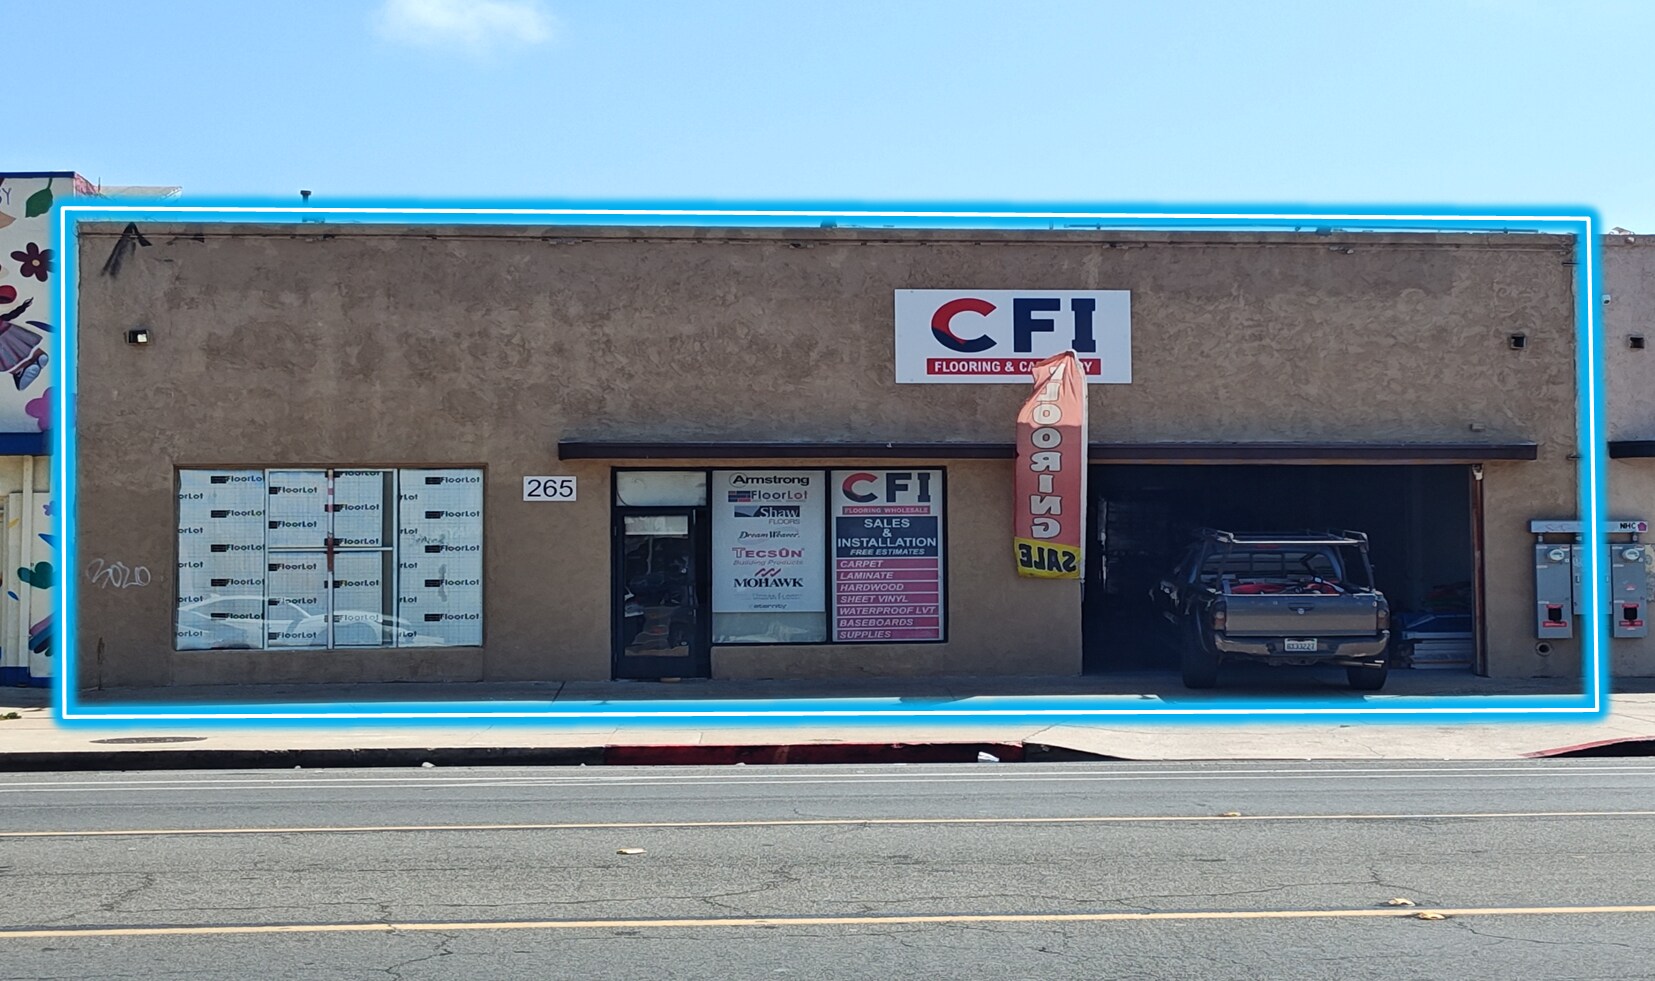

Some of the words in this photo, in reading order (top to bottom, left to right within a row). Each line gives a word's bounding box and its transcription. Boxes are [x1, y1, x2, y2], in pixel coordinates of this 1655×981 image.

[931, 298, 1096, 352] CFI
[935, 361, 1000, 372] FLOORING
[1004, 361, 1014, 372] &
[732, 475, 810, 486] Armstrong
[528, 480, 573, 497] 265
[842, 472, 930, 503] CFI
[751, 490, 808, 500] FloorLot
[760, 506, 799, 518] Shaw
[864, 518, 910, 528] SALES
[882, 528, 892, 538] &
[838, 538, 936, 548] INSTALLATION
[840, 560, 883, 568] CARPET
[734, 578, 804, 588] MOHAWK
[840, 584, 904, 592] HARDWOOD
[840, 606, 914, 615] WATERPROOF
[840, 618, 914, 627] BASEBOARDS
[840, 630, 892, 639] SUPPLIES
